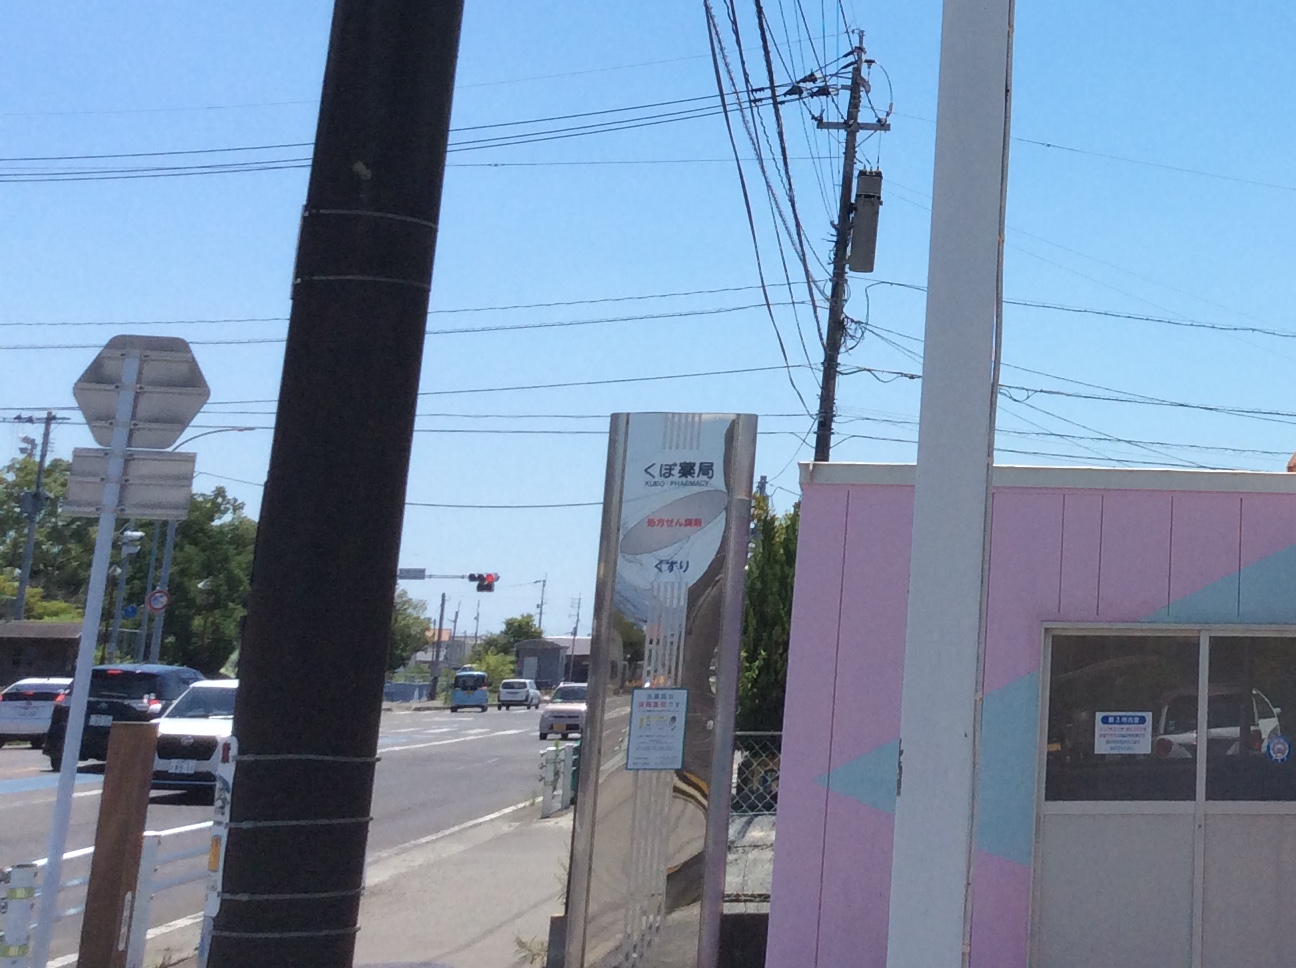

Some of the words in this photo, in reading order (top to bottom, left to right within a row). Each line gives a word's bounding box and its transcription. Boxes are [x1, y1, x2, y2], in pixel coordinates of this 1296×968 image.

[643, 461, 715, 480] くぼ薬局
[644, 480, 666, 488] KUBO
[669, 480, 710, 488] PHARMACY
[654, 559, 690, 574] くすり
